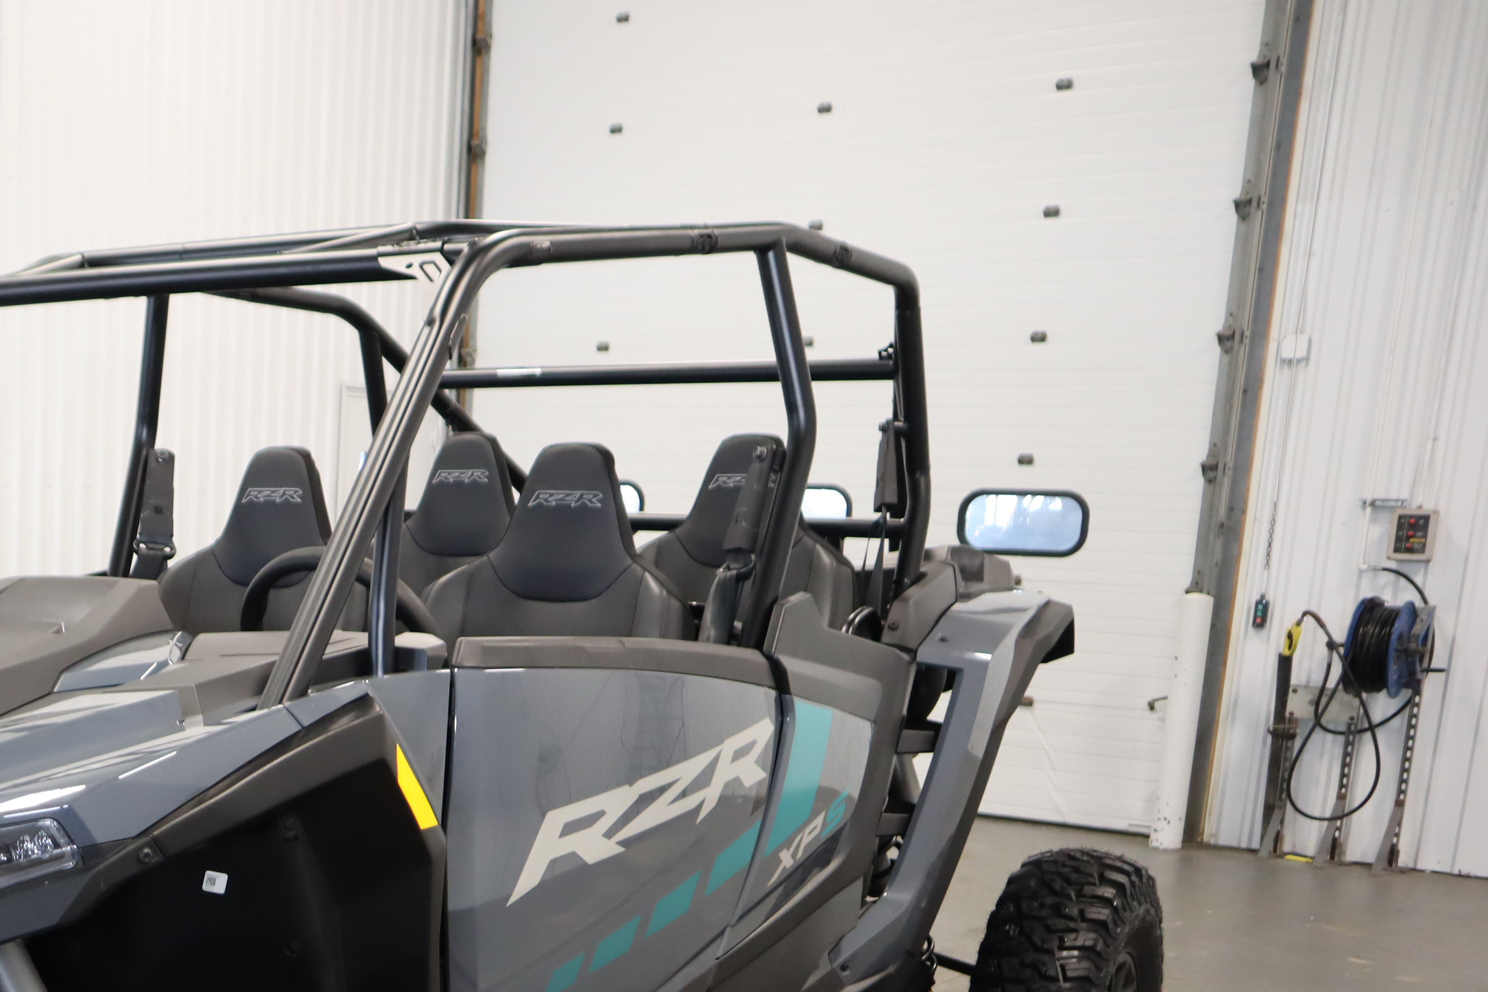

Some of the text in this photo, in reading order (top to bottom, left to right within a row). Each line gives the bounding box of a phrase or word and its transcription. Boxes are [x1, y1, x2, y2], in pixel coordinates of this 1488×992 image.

[708, 473, 747, 489] RZ
[241, 486, 303, 506] RZR
[527, 488, 603, 508] RZR
[506, 717, 775, 907] RZR
